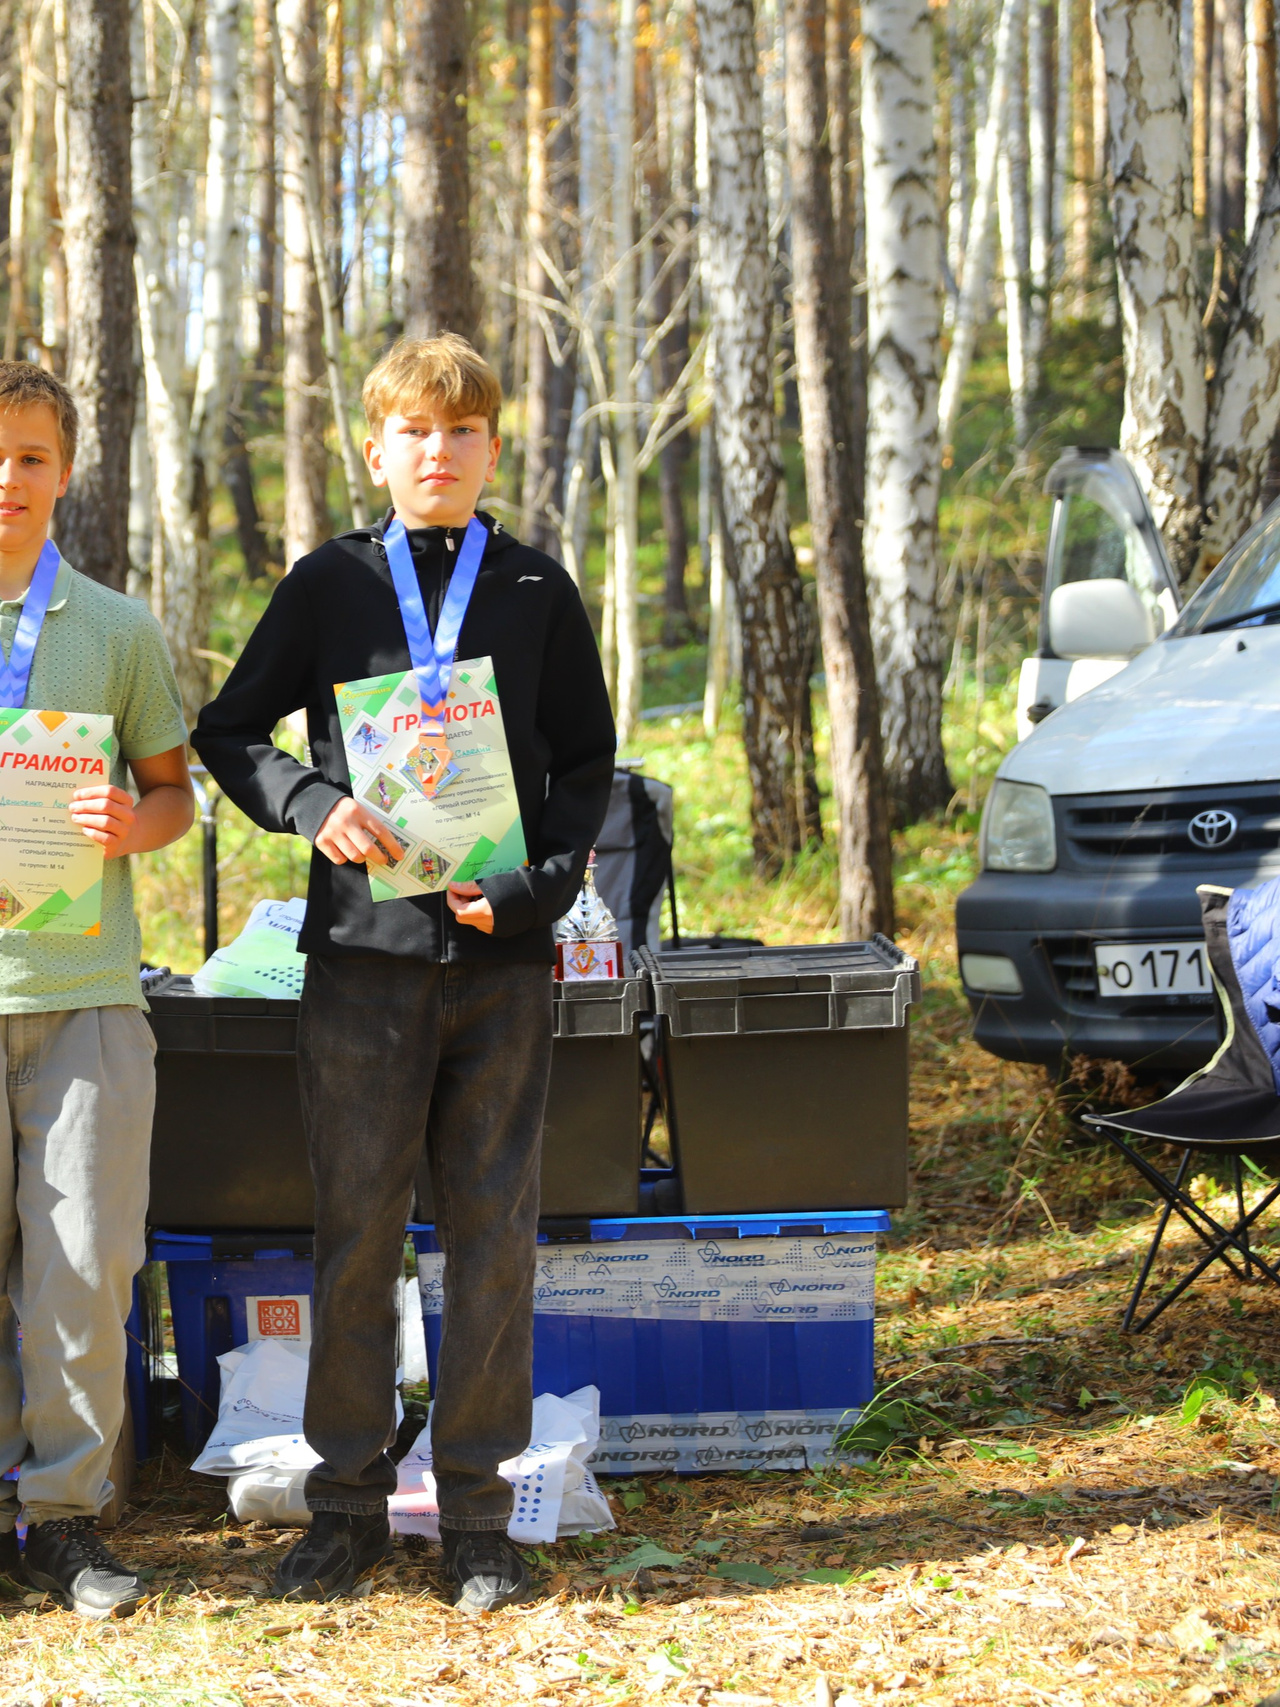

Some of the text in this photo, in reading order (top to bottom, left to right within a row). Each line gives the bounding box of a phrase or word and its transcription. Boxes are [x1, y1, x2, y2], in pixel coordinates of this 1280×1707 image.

[392, 699, 496, 733] ГРМОТА
[0, 751, 104, 776] ГРАМОТА
[24, 780, 77, 790] НАГРАЖДАЕТСЯ
[472, 810, 481, 818] 14
[604, 959, 614, 978] 1
[836, 1244, 875, 1255] NOR
[596, 1254, 650, 1263] NORD
[712, 1254, 765, 1264] NORD
[553, 1287, 606, 1297] NORD
[792, 1283, 846, 1293] NORD
[671, 1290, 721, 1299] NORD
[263, 1306, 295, 1317] ROX
[766, 1304, 819, 1314] NORD
[264, 1319, 296, 1329] BOX
[648, 1426, 730, 1438] NORD
[599, 1451, 681, 1463] NORD
